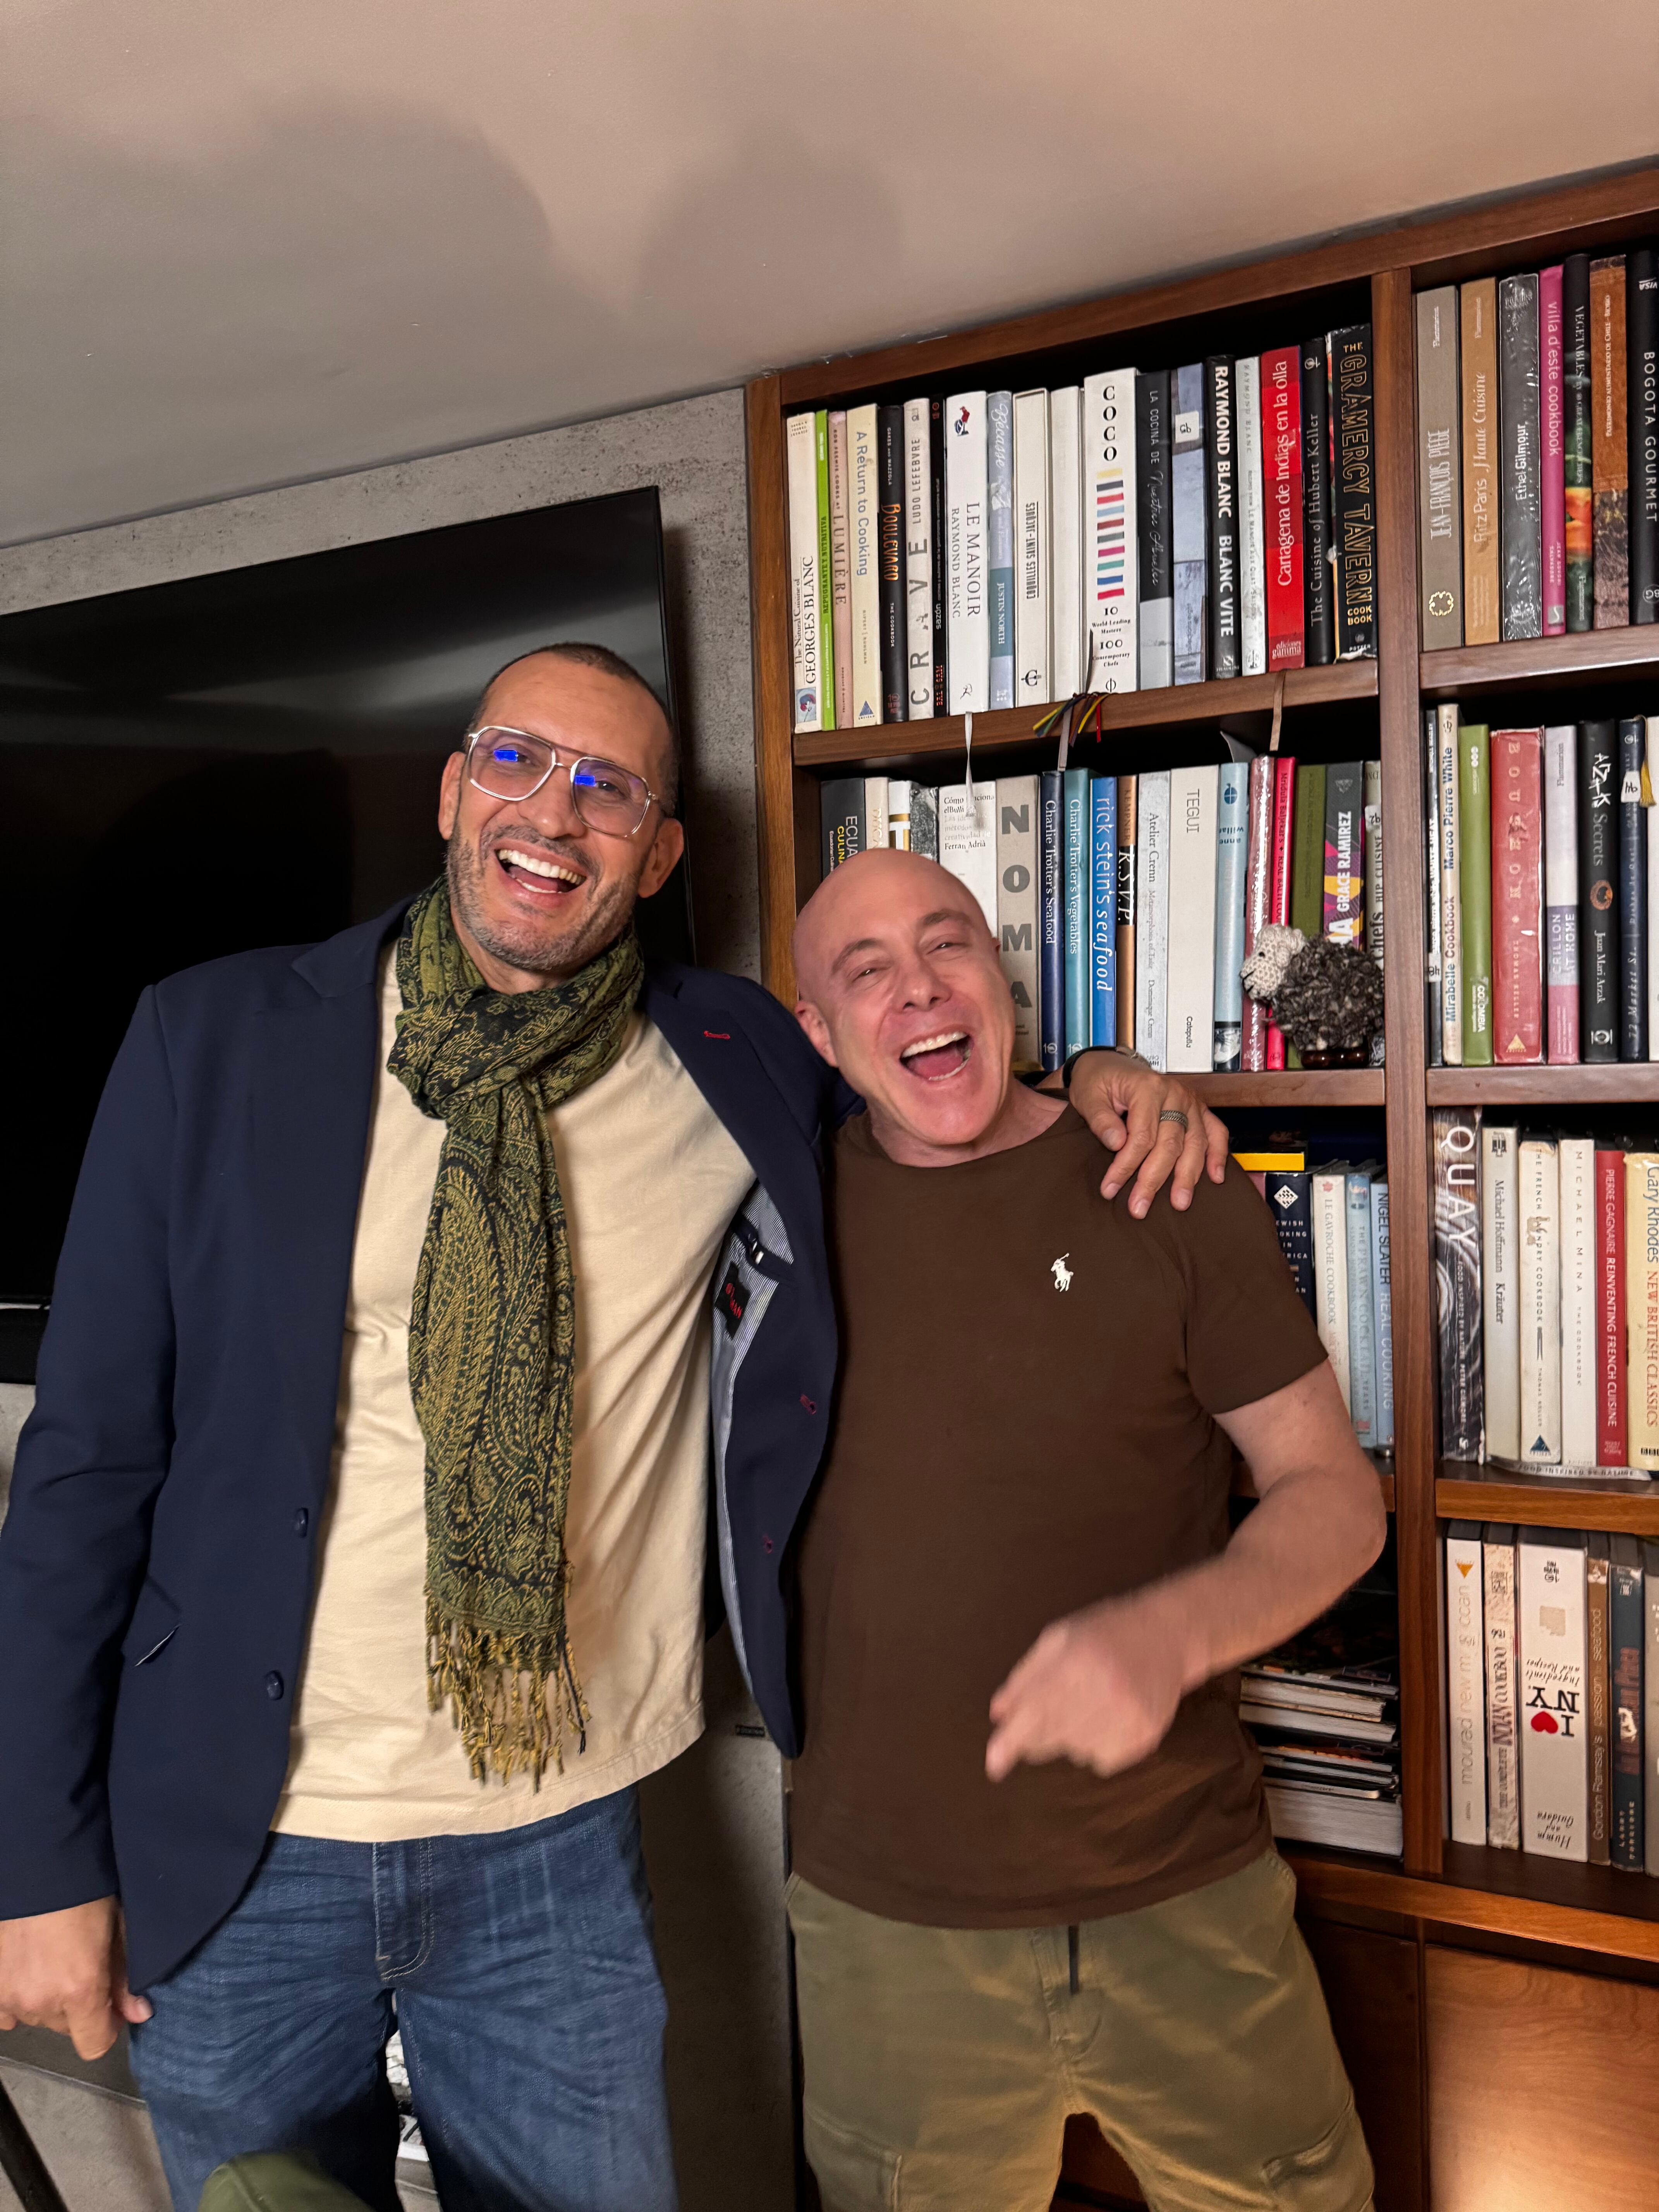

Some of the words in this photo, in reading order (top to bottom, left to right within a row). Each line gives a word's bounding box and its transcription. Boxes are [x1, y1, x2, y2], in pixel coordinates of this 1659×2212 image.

[1638, 282, 1657, 290] VISA
[1547, 302, 1559, 332] villa
[1343, 342, 1363, 353] THE
[1547, 336, 1561, 380] d'este
[1575, 305, 1585, 378] VEGETABLES
[1273, 360, 1287, 389] olla
[1644, 352, 1656, 426] BOGOTA
[1150, 390, 1158, 403] LA
[1215, 366, 1230, 455] RAYMOND
[1274, 392, 1288, 408] la
[1472, 372, 1486, 423] Cuisine
[856, 431, 867, 442] A
[990, 403, 1008, 468] Bécasse
[1103, 386, 1117, 462] COCO
[1150, 409, 1159, 445] COCINA
[1277, 410, 1288, 430] en
[1307, 414, 1319, 456] Keller
[1340, 354, 1371, 495] GRAMERCY
[1548, 386, 1561, 456] cookbook
[910, 438, 921, 492] LEFEBVRE
[1151, 452, 1159, 464] DE
[1275, 434, 1290, 481] Indias
[1515, 424, 1527, 469] Gilmour
[857, 445, 869, 496] Return
[1217, 461, 1232, 519] BLANC
[1309, 462, 1321, 513] Hubert
[1515, 471, 1527, 501] Ethel
[1644, 437, 1657, 522] GOURMET
[857, 498, 869, 514] to
[910, 497, 921, 524] LUDO
[966, 502, 980, 526] LE
[1275, 484, 1290, 505] de
[1474, 478, 1487, 514] Paris
[881, 503, 902, 581] BOULEVARD
[951, 507, 960, 571] RAYMOND
[1309, 517, 1324, 531] of
[1474, 514, 1487, 543] Ritz
[833, 515, 849, 605] LUMIÈRE
[855, 517, 870, 576] Cooking
[1219, 535, 1233, 593] BLANC
[1276, 508, 1293, 586] Cartagena
[1310, 537, 1322, 592] Cuisine
[1344, 503, 1374, 605] TAVERN
[802, 555, 815, 609] BLANC
[966, 533, 981, 617] MANOIR
[1025, 562, 1036, 599] COQUILLES
[934, 603, 943, 630] sazón
[951, 577, 960, 618] BLANC
[997, 582, 1005, 611] JUSTIN
[1104, 606, 1118, 616] 10
[1309, 597, 1323, 627] The
[1347, 605, 1372, 616] COOK
[795, 618, 803, 646] Natural
[997, 613, 1005, 644] NORTH
[1092, 620, 1107, 628] World
[1220, 599, 1233, 638] VITE
[1348, 614, 1372, 626] BOOK
[795, 652, 803, 668] The
[803, 612, 817, 684] GEORGES
[1092, 652, 1130, 661] Contemporary
[1100, 639, 1123, 649] 100
[1442, 747, 1452, 784] White
[1279, 772, 1288, 803] Mridula
[1443, 788, 1453, 826] Pierre
[1045, 800, 1056, 843] Charlie
[1070, 799, 1080, 843] Charlie
[1096, 798, 1114, 833] rick
[1149, 812, 1159, 848] Atelier
[1187, 788, 1200, 833] TEGUI
[968, 840, 986, 849] Adrià
[1338, 811, 1352, 869] RAMIREZ
[1374, 836, 1383, 878] CUISINE
[1443, 831, 1454, 870] Marco
[1592, 813, 1608, 866] Secrets
[1045, 845, 1056, 894] Trotter's
[1070, 843, 1080, 892] Trotter's
[1096, 842, 1115, 903] stein's
[1149, 850, 1159, 882] Crenn
[1336, 871, 1350, 912] GRACE
[1375, 883, 1383, 903] HIP
[1045, 897, 1056, 944] Seafood
[1067, 894, 1080, 954] Vegetables
[1369, 912, 1384, 961] Chefs
[1444, 896, 1455, 959] Cookbook
[1565, 913, 1575, 952] HOME
[1594, 929, 1606, 952] Juan
[1092, 909, 1113, 991] seafood
[1552, 914, 1561, 975] CRILLON
[1566, 957, 1575, 972] AT
[1597, 953, 1606, 975] Mari
[1445, 963, 1456, 1022] Mirabelle
[1477, 985, 1486, 1032] COLOMBIA
[1597, 977, 1606, 1004] Arzak
[1628, 971, 1637, 1017] Market
[1324, 1199, 1332, 1209] LE
[1440, 1126, 1475, 1248] QUAY
[1494, 1180, 1504, 1219] Michael
[1605, 1169, 1615, 1202] PIERRE
[1377, 1192, 1389, 1232] NIGEL
[1606, 1202, 1616, 1254] GAGNAIRE
[1324, 1213, 1334, 1265] GAVROCHE
[1495, 1221, 1505, 1273] Hoffmann
[1647, 1207, 1659, 1262] Rhodes
[1379, 1235, 1390, 1285] SLATER
[1326, 1268, 1336, 1324] COOKBOOK
[1496, 1283, 1505, 1324] Kräuter
[1606, 1257, 1616, 1333] REINVENTING
[1647, 1271, 1658, 1302] NEW
[1380, 1293, 1391, 1331] REAL
[1647, 1306, 1658, 1361] BRITISH
[1607, 1335, 1616, 1379] FRENCH
[1607, 1381, 1617, 1427] CUISINE
[1647, 1364, 1658, 1428] CLASSICS
[1590, 1608, 1602, 1661] seafood
[1525, 1670, 1580, 1687] Ingredients
[1563, 1663, 1580, 1673] and
[1526, 1686, 1580, 1714] NY
[1561, 1714, 1575, 1738] I
[1592, 1735, 1605, 1793] Ramsay's
[1593, 1795, 1603, 1840] Gordon
